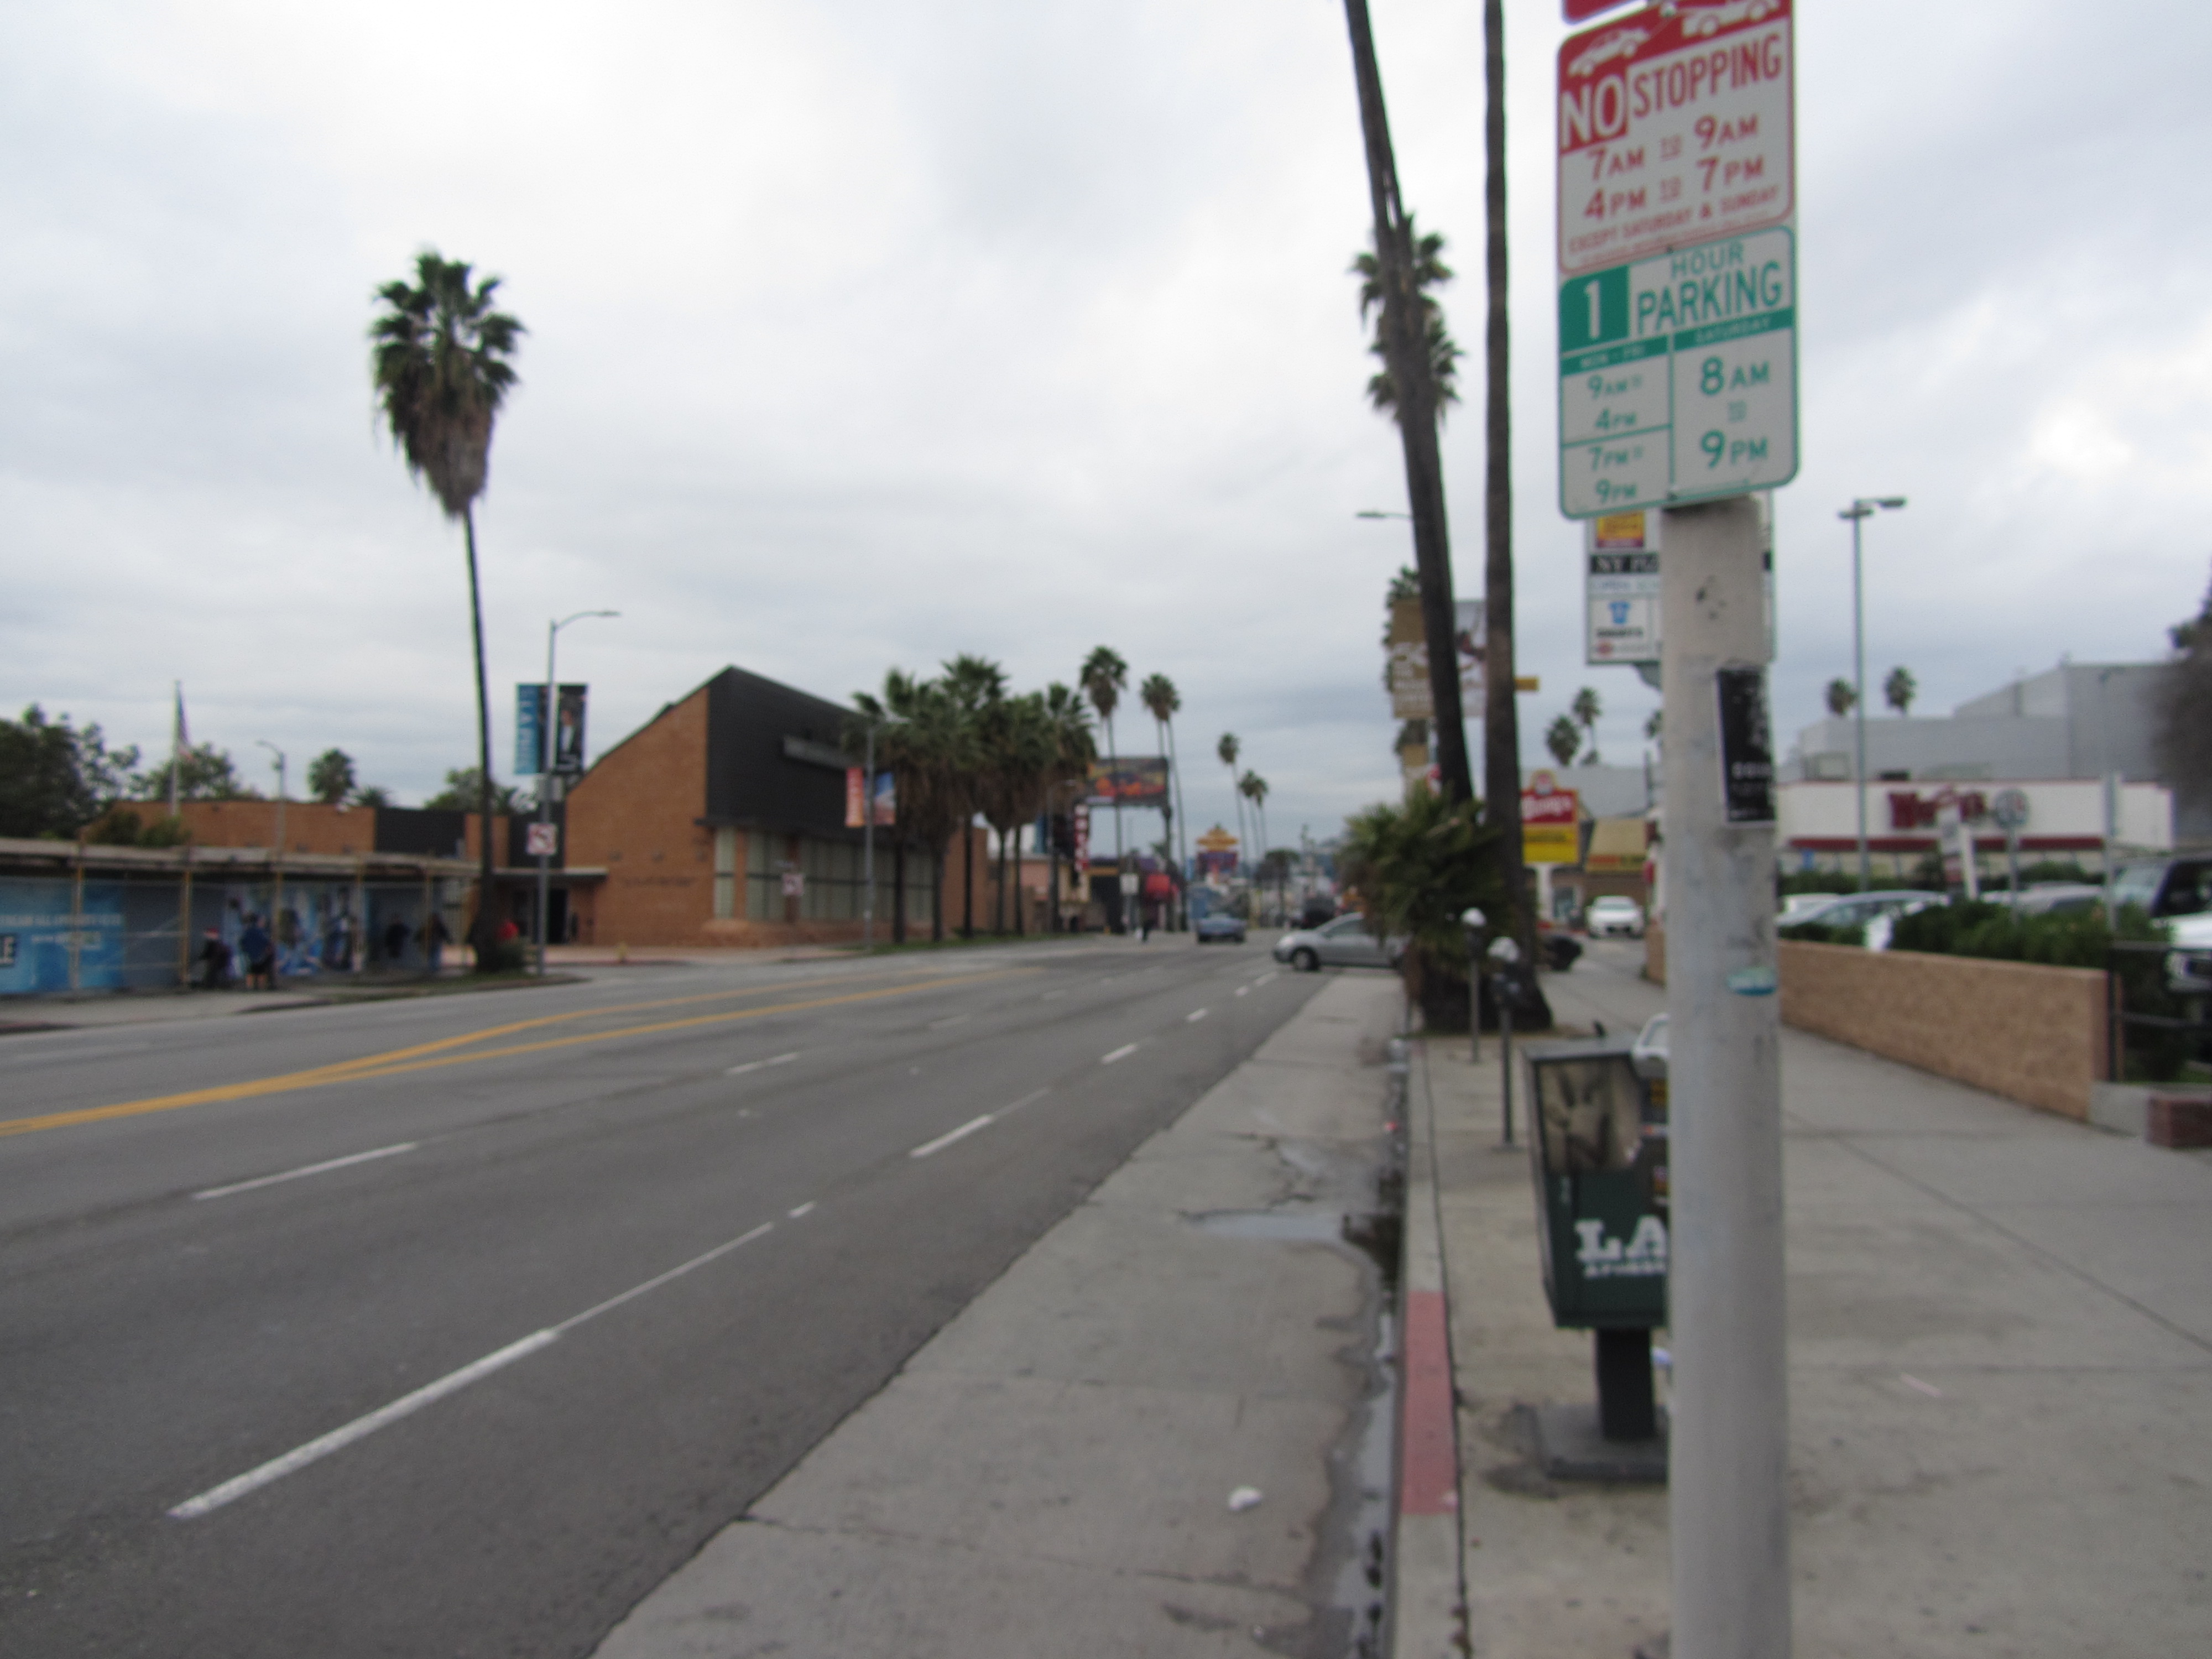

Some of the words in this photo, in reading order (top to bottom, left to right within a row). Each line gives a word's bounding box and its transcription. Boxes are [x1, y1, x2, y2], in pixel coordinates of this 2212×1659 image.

[1561, 74, 1626, 150] NO
[1633, 33, 1781, 118] STOPPING
[1671, 242, 1744, 279] HOUR
[1584, 279, 1600, 340] 1
[1637, 260, 1782, 334] PARKING
